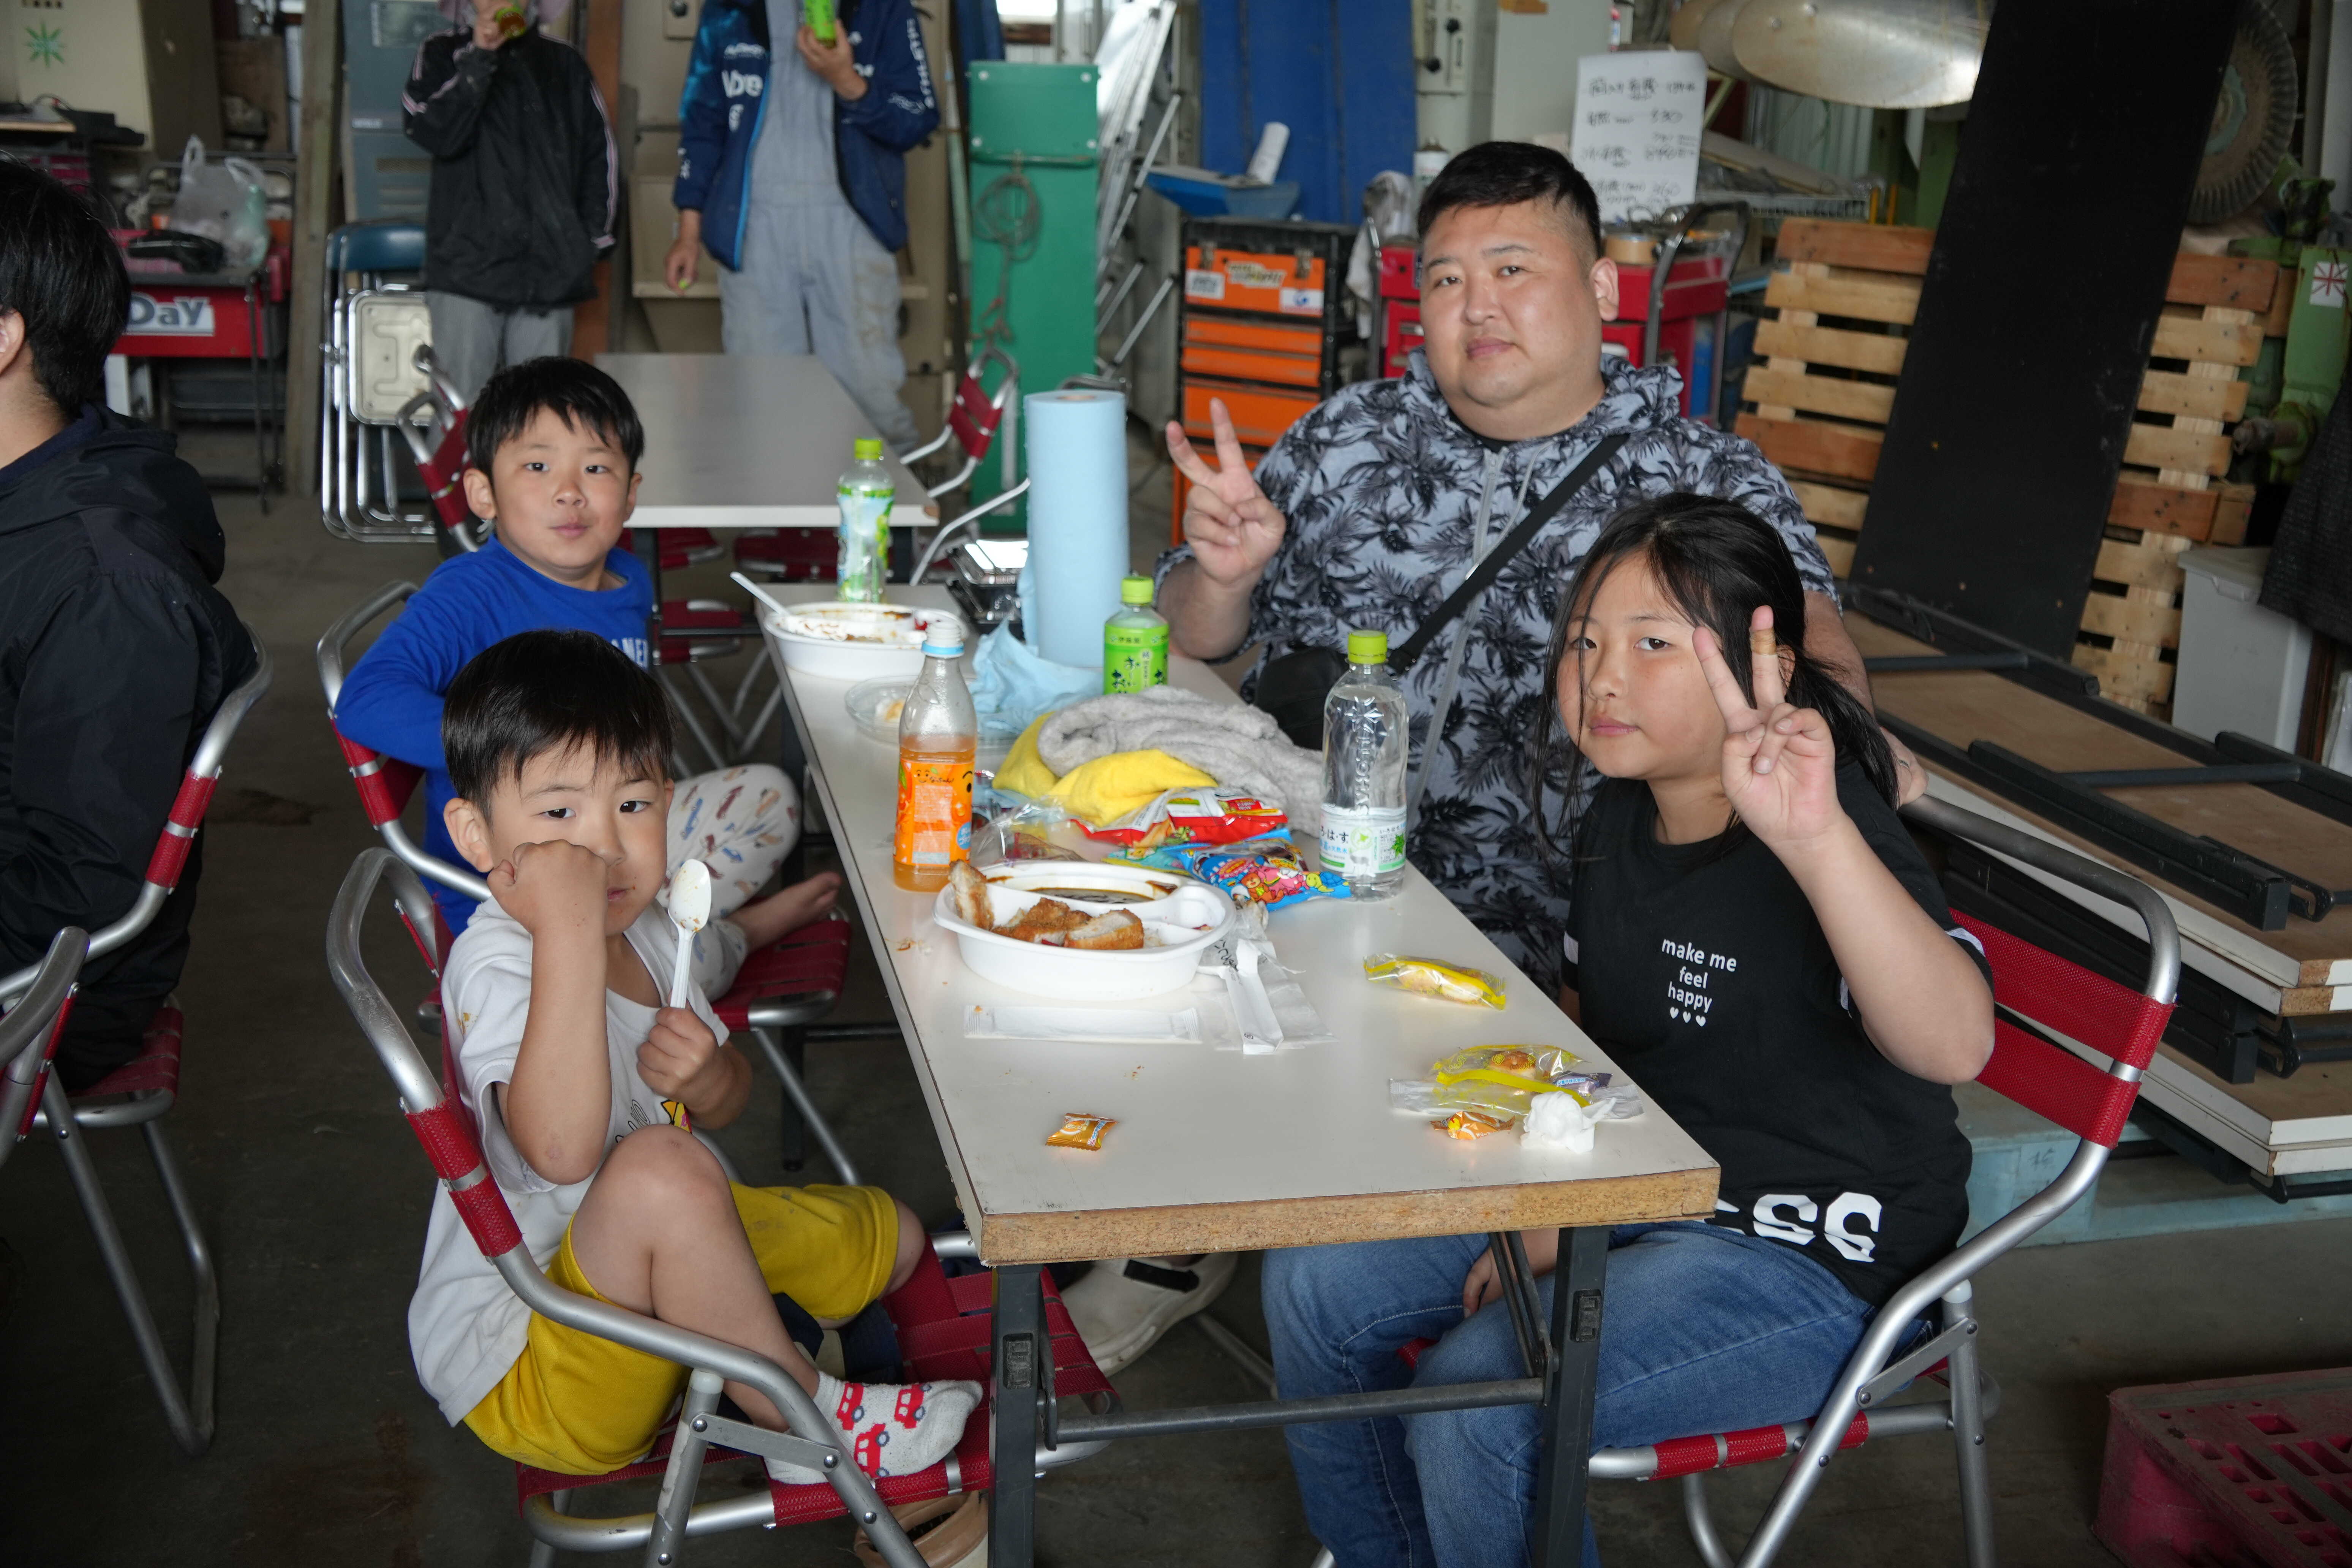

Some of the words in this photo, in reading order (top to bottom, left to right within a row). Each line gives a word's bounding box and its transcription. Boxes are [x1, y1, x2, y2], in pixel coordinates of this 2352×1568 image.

[1662, 939, 1705, 964] make
[1709, 953, 1737, 972] me
[1679, 966, 1708, 989] feel
[1668, 981, 1713, 1013] happy
